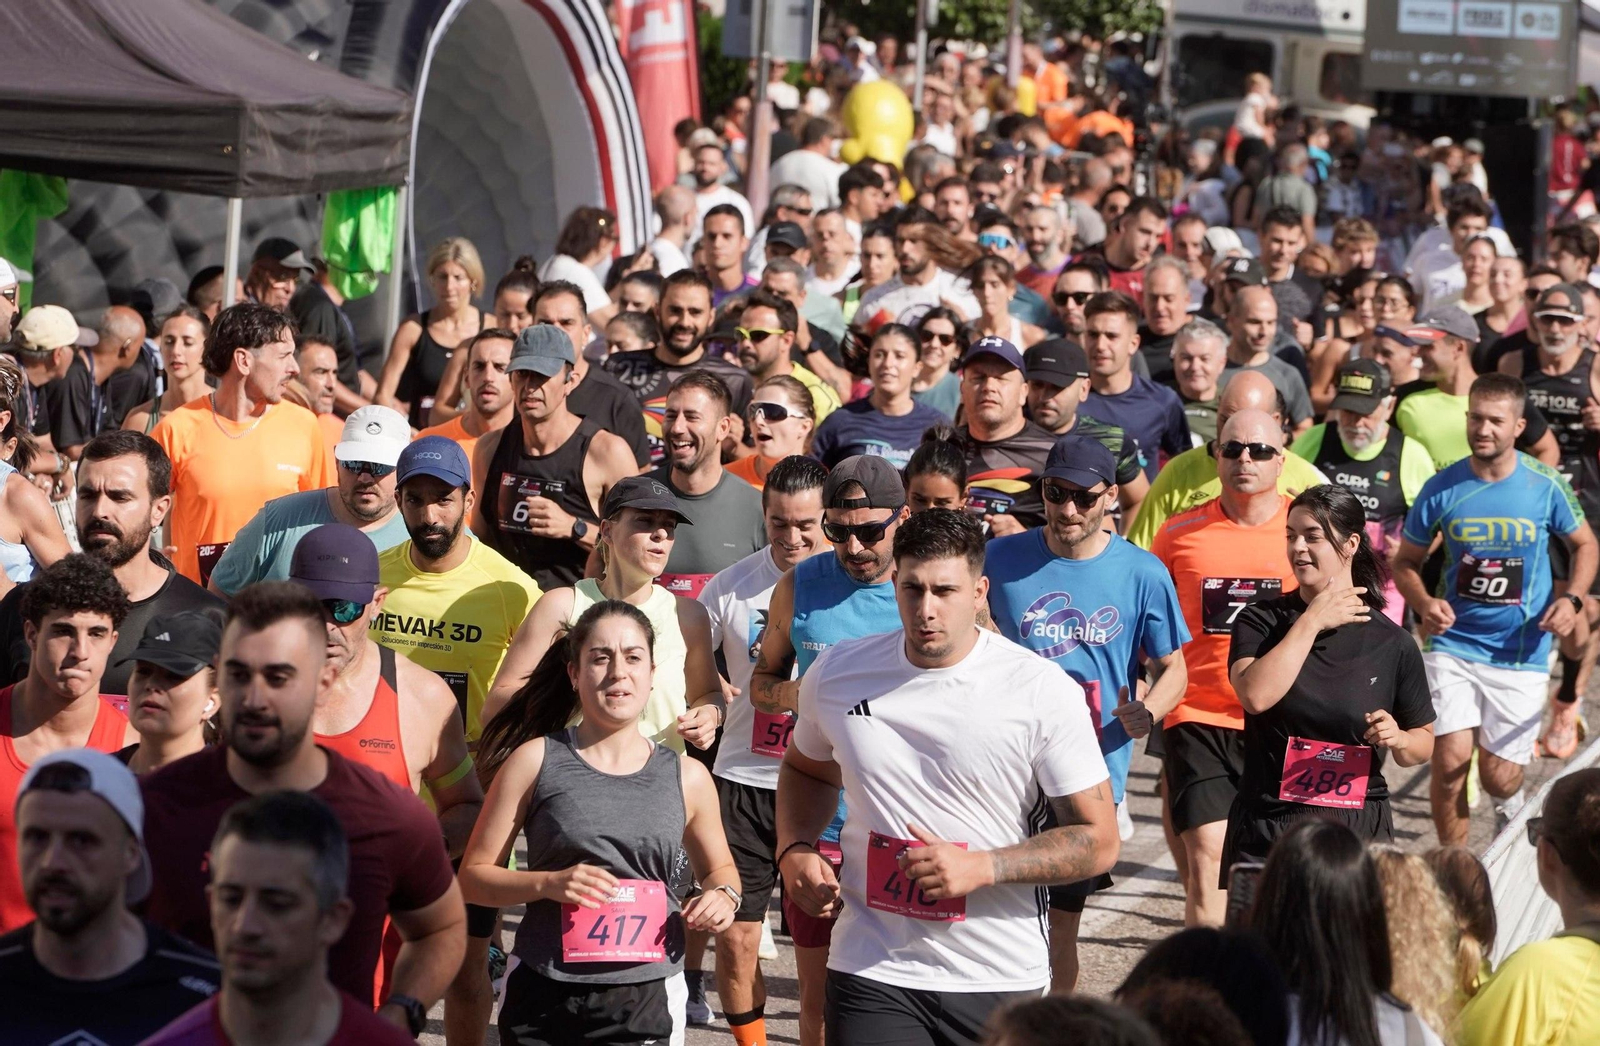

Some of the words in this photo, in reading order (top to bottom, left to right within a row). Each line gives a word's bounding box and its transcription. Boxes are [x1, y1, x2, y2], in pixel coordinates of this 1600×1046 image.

[1469, 577, 1509, 597] 90
[1225, 602, 1247, 624] 7
[381, 635, 410, 647] Soluciones
[410, 639, 417, 647] en
[417, 639, 444, 653] impresión
[444, 643, 452, 652] 3D
[449, 622, 483, 644] 3D
[1034, 622, 1107, 644] aqualia
[1295, 766, 1356, 797] 486
[587, 914, 648, 946] 417
